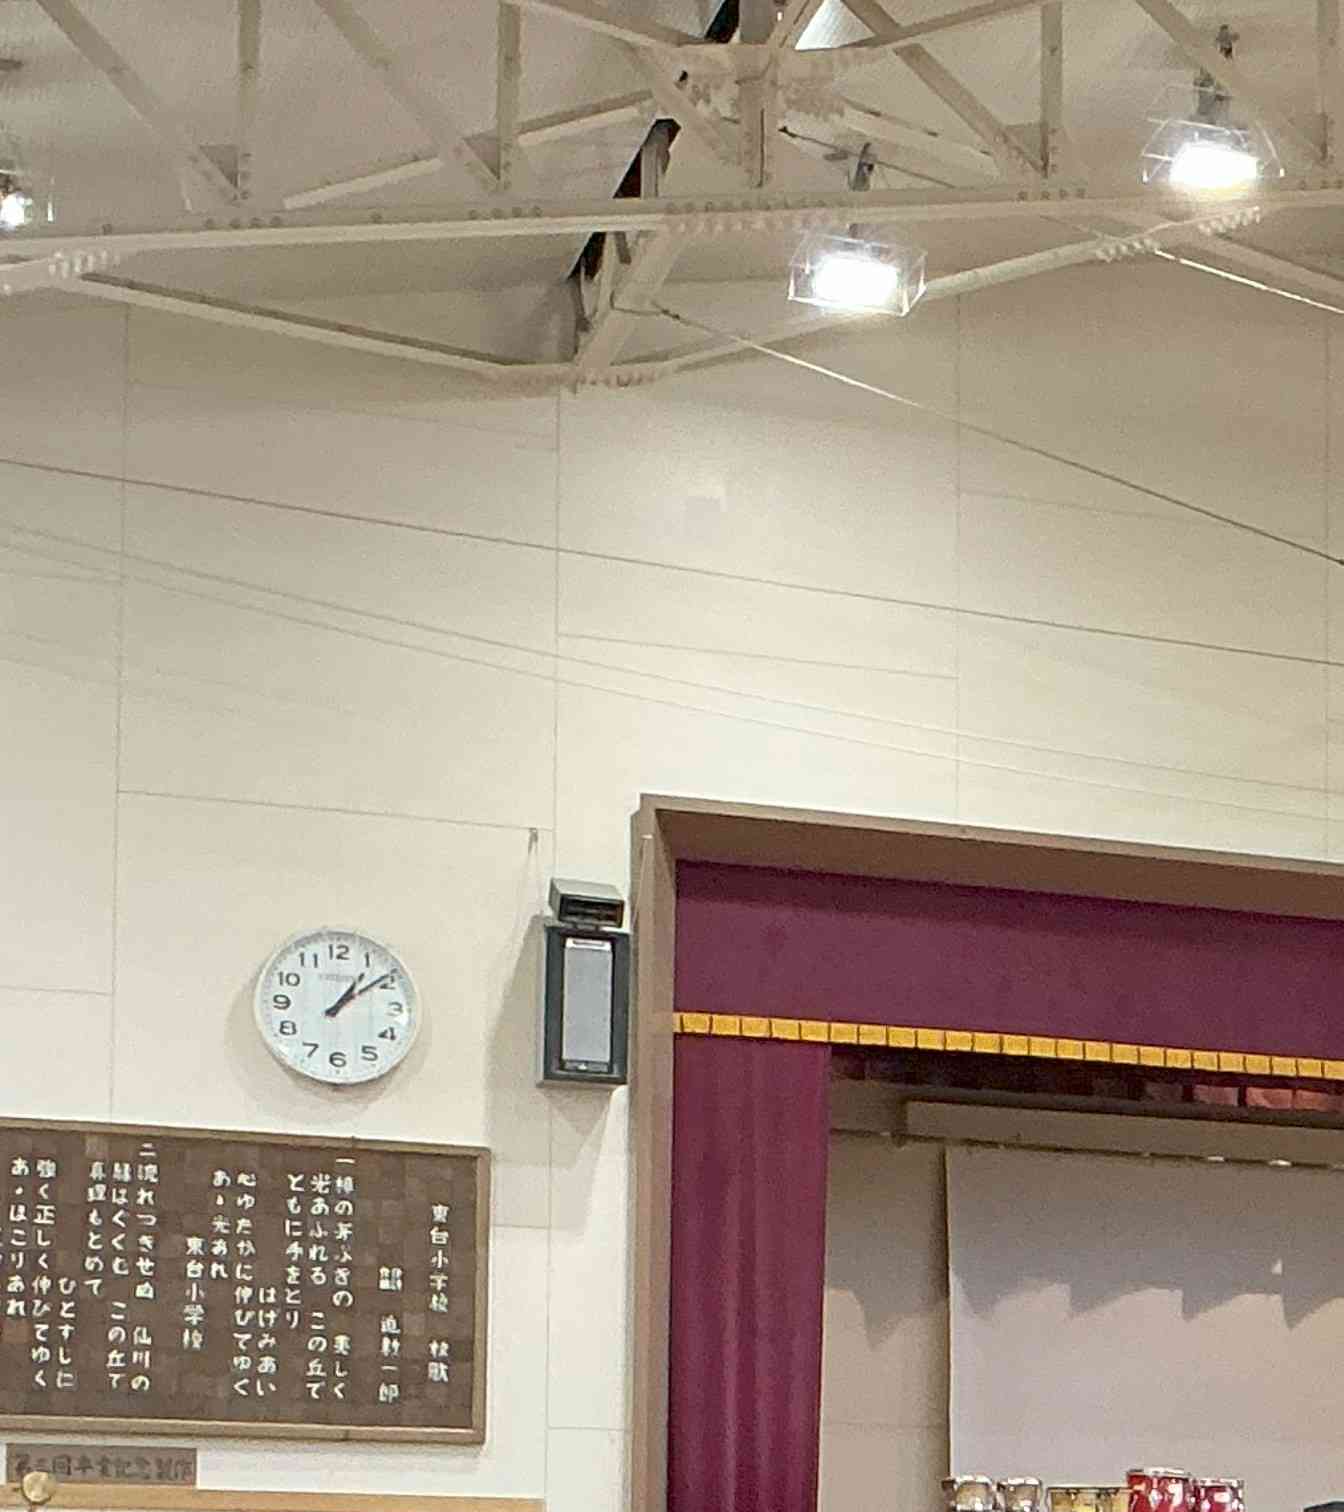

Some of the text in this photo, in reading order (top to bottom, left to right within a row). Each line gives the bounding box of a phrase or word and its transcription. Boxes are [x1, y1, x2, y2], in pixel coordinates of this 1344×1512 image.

[300, 952, 318, 968] 11
[328, 944, 349, 960] 12
[279, 971, 300, 987] 10
[273, 994, 291, 1010] 9
[388, 1001, 402, 1016] 3
[279, 1020, 297, 1036] 8
[378, 1027, 397, 1041] 4
[302, 1041, 320, 1058] 7
[361, 1045, 378, 1061] 5
[329, 1052, 347, 1068] 6
